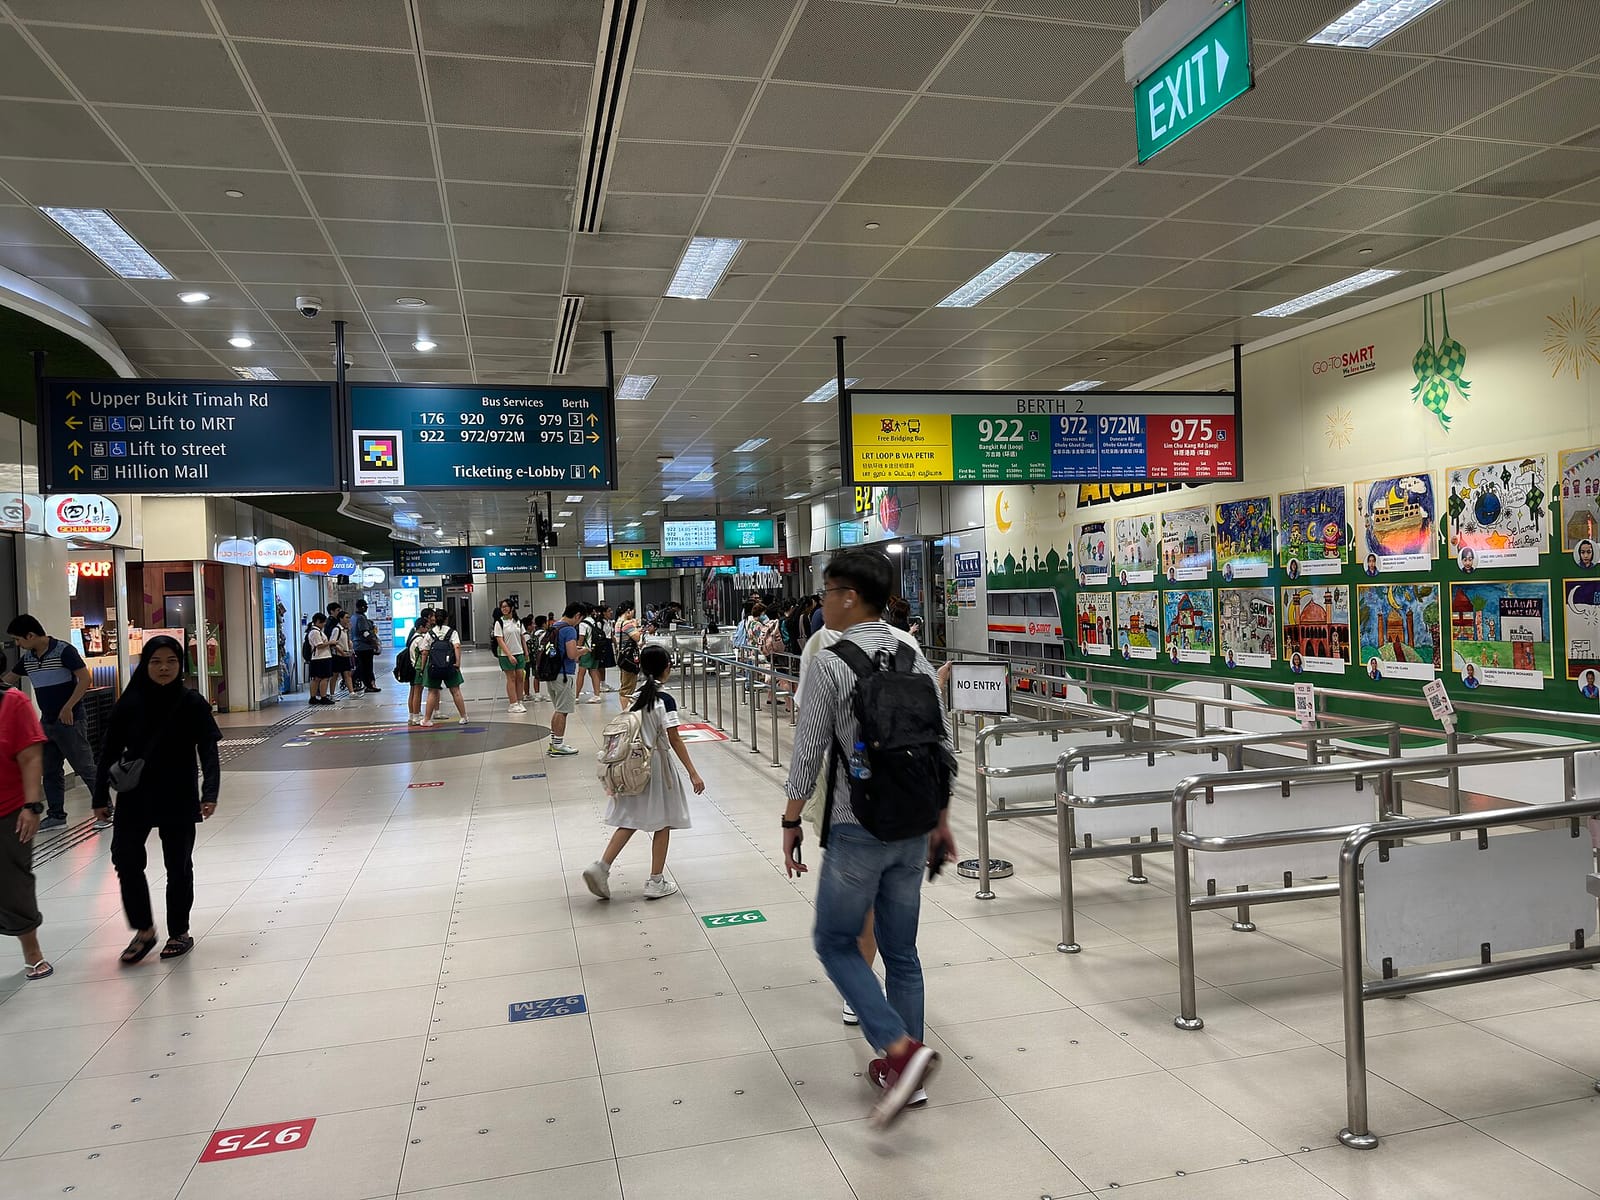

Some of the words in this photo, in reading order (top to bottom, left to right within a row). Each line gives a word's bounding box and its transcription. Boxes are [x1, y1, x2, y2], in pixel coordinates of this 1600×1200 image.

[1148, 45, 1209, 141] EXIT
[90, 392, 140, 409] Upper
[146, 392, 189, 406] Bukit
[193, 393, 243, 407] Timah
[249, 393, 269, 407] Rd
[482, 397, 501, 407] Bus
[503, 397, 544, 408] Services
[562, 398, 589, 408] Berth
[1016, 399, 1066, 413] BERTH
[1075, 399, 1084, 413] 2
[149, 416, 175, 431] Lift
[179, 418, 196, 431] to
[201, 417, 236, 431] MRT
[420, 413, 445, 425] 176
[460, 414, 485, 425] 920
[500, 414, 524, 426] 976
[539, 414, 562, 426] 979
[572, 415, 580, 425] 3
[1060, 416, 1088, 435] 972
[1100, 416, 1140, 435] 972M
[420, 430, 445, 442] 922
[460, 430, 525, 443] 972/972M
[540, 431, 564, 443] 975
[573, 433, 581, 442] 2
[978, 419, 1024, 442] 922
[1170, 419, 1213, 441] 975
[890, 435, 913, 443] Bridging
[130, 441, 155, 456] Lift
[161, 442, 177, 456] to
[182, 442, 227, 456] street
[115, 464, 169, 479] Hillion
[175, 465, 209, 479] Mall
[452, 465, 513, 479] Ticketing
[516, 465, 566, 480] e-Lobby
[1506, 521, 1536, 537] Selamat
[1508, 537, 1523, 548] Hari
[620, 550, 634, 558] 176
[650, 550, 660, 558] 92
[1500, 599, 1538, 608] SELAMAT
[957, 680, 971, 689] NO
[973, 680, 1001, 690] ENTRY
[708, 912, 758, 925] 922
[514, 997, 579, 1012] 972M
[525, 1006, 570, 1019] 972
[214, 1126, 303, 1155] 975
